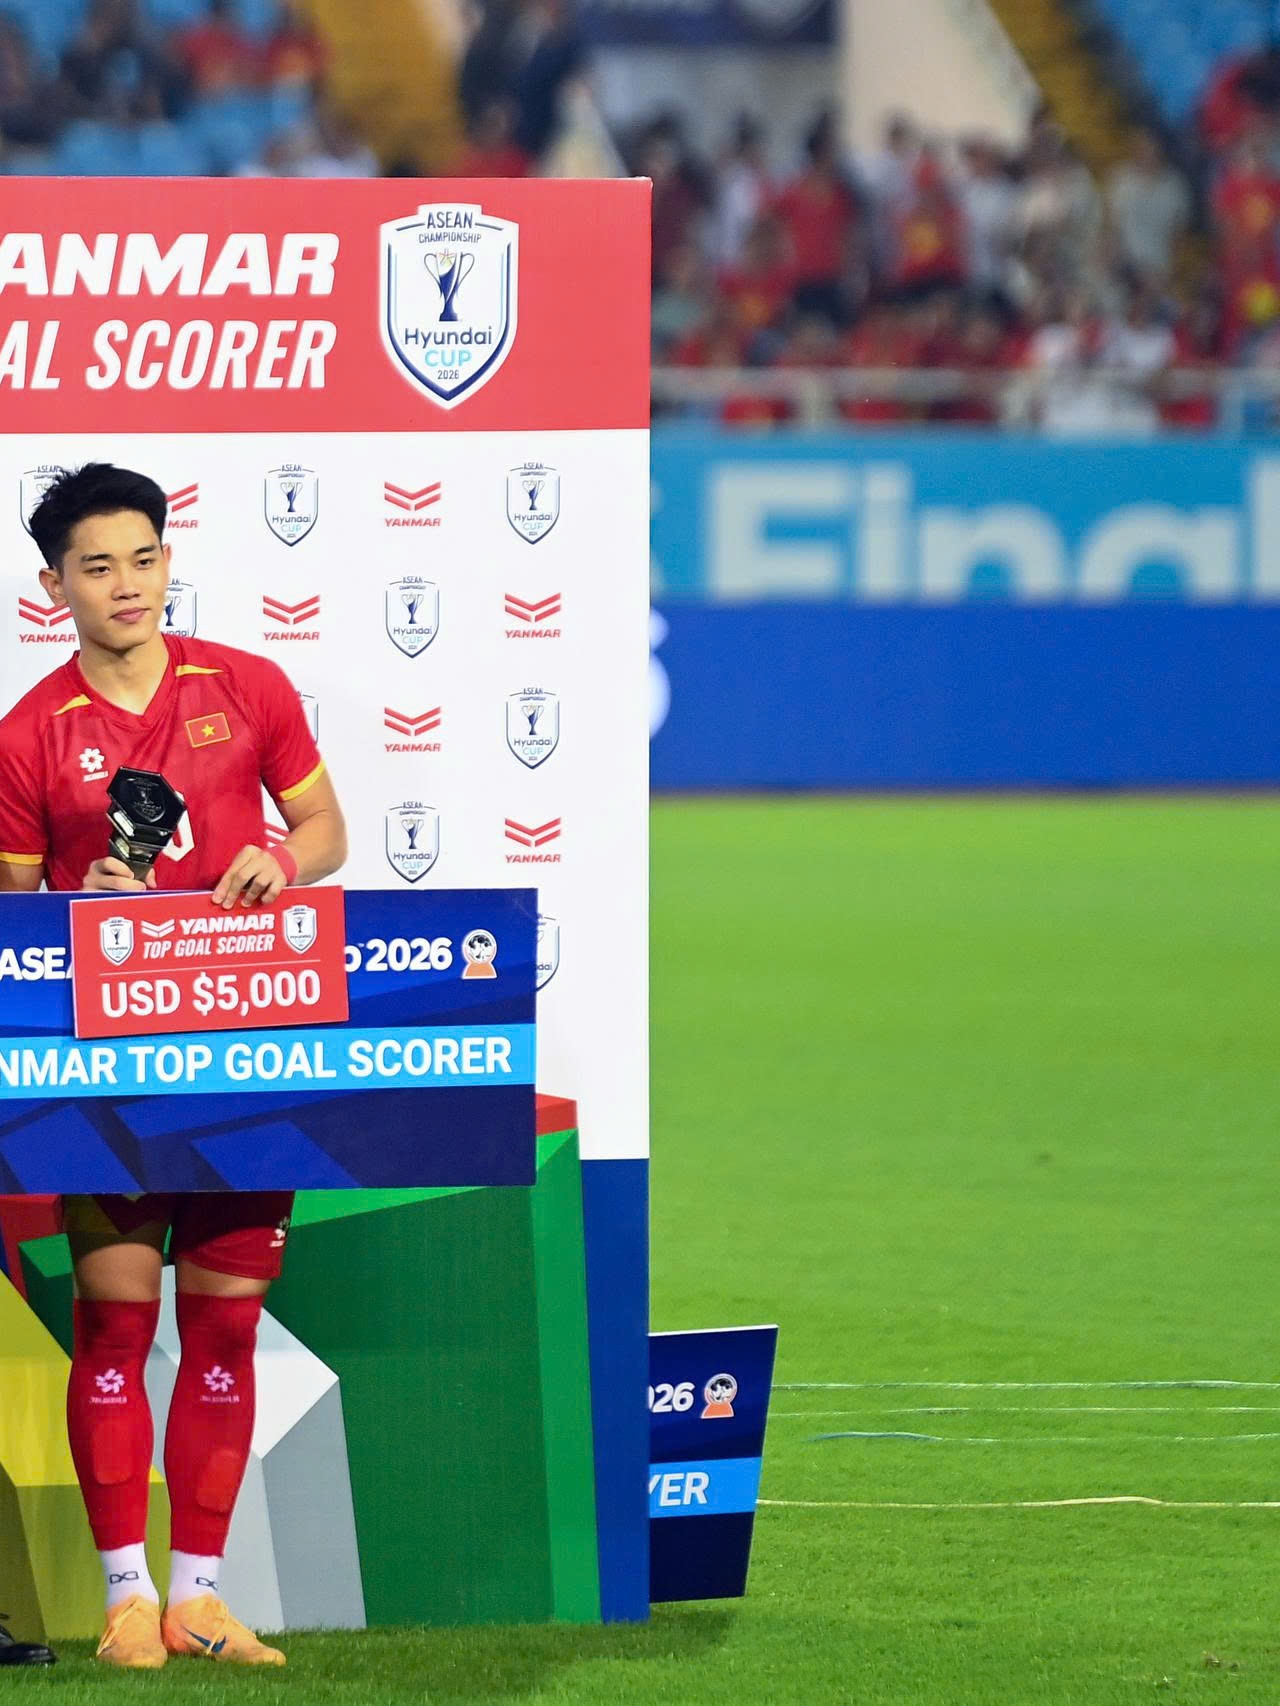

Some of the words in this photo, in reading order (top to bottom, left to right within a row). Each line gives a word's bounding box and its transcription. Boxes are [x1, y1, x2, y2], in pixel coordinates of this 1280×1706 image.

[426, 210, 474, 229] ASEAN
[418, 231, 482, 244] CHAMPIONSHIP
[404, 326, 492, 350] Hyundai
[84, 319, 338, 391] SCORER
[424, 349, 473, 368] CUP
[436, 369, 460, 380] 2026
[167, 519, 198, 529] MAR
[386, 518, 441, 527] YANMAR
[19, 633, 77, 643] YANMAR
[264, 631, 321, 641] YANMAR
[506, 628, 561, 638] YANMAR
[386, 743, 441, 752] YANMAR
[505, 854, 561, 863] YANMAR
[178, 913, 276, 936] YANMAR
[143, 940, 172, 960] TOP
[174, 937, 212, 958] GOAL
[216, 933, 276, 955] SCORER
[365, 936, 454, 972] 2026
[101, 979, 182, 1018] USD
[192, 969, 321, 1017] $5,000
[128, 1045, 213, 1084] TOP
[224, 1040, 338, 1081] GOAL
[347, 1036, 514, 1078] SCORER
[648, 1381, 696, 1413] 26
